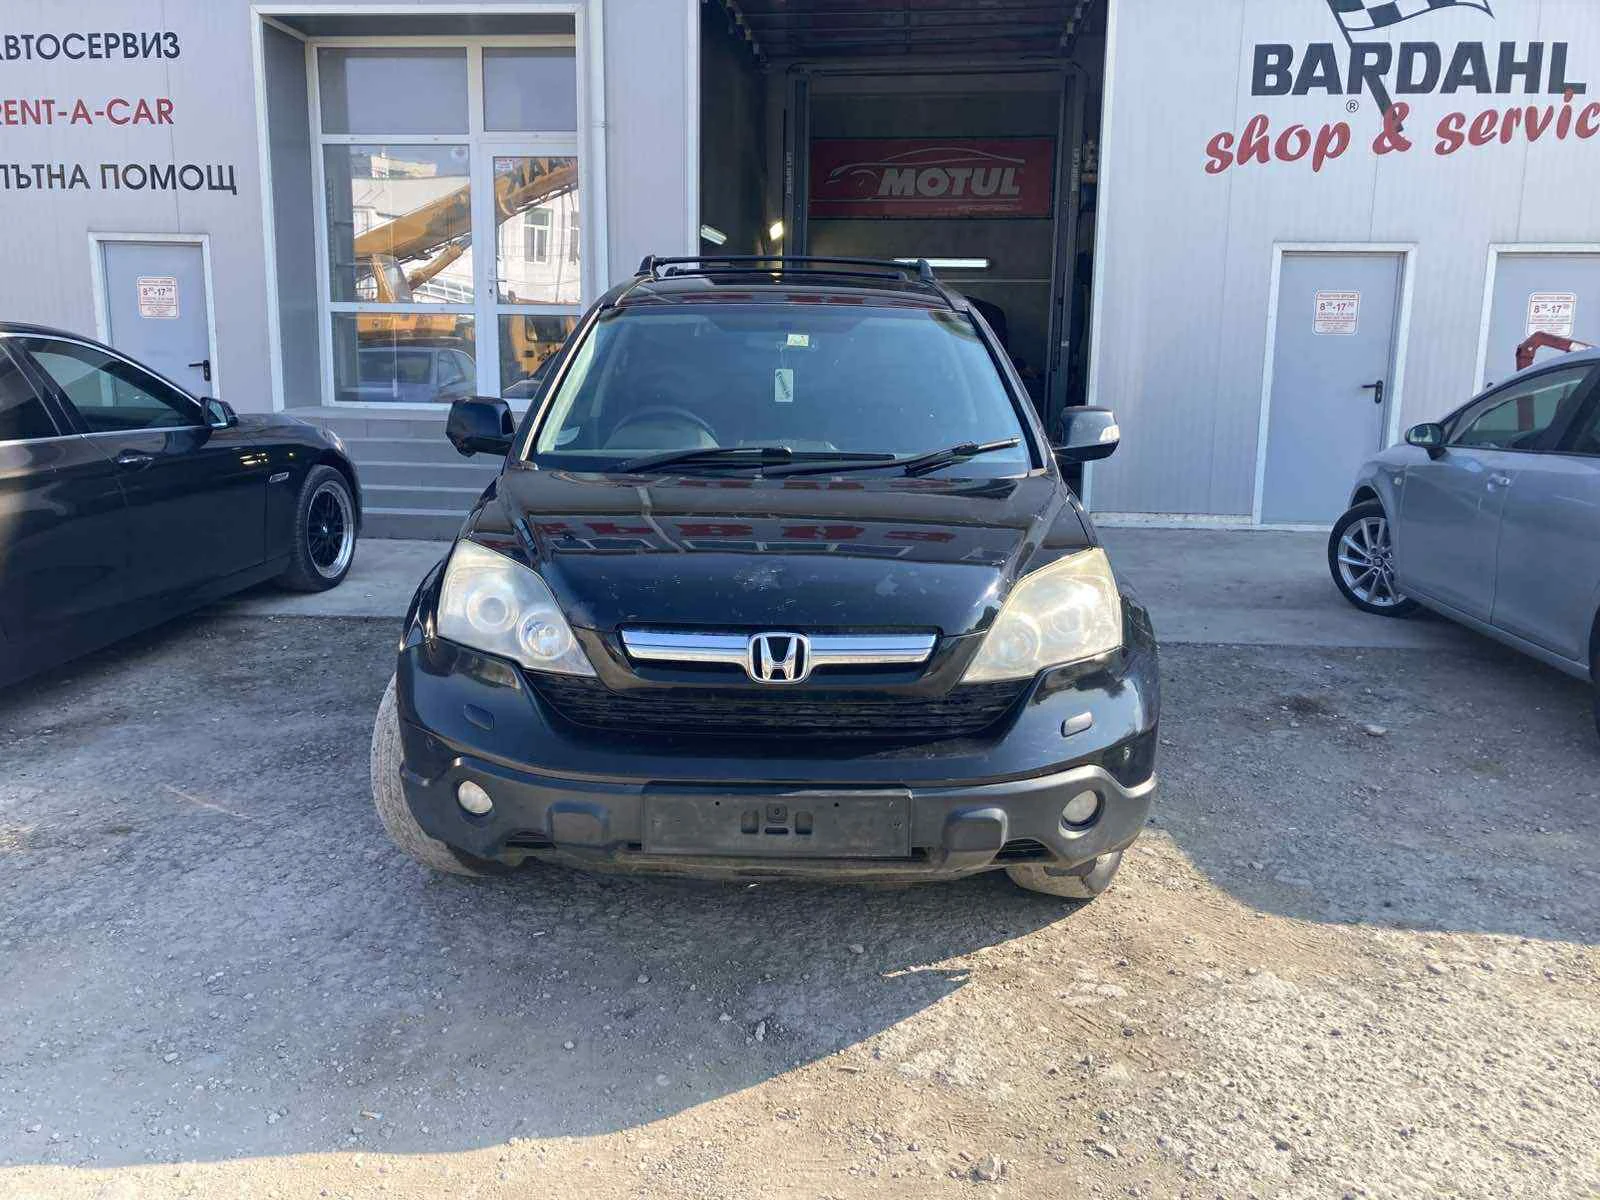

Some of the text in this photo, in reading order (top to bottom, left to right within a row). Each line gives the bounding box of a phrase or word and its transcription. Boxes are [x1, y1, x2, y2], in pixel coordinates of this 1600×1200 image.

[0, 32, 181, 60] ВТОСЕРВИЗ
[1251, 41, 1587, 96] BARDAHL
[0, 98, 175, 125] ENT-A-CAR
[1204, 114, 1351, 174] shop
[1372, 102, 1412, 155] &
[100, 163, 238, 195] ПОМОЩ
[878, 167, 1021, 196] MOTUL
